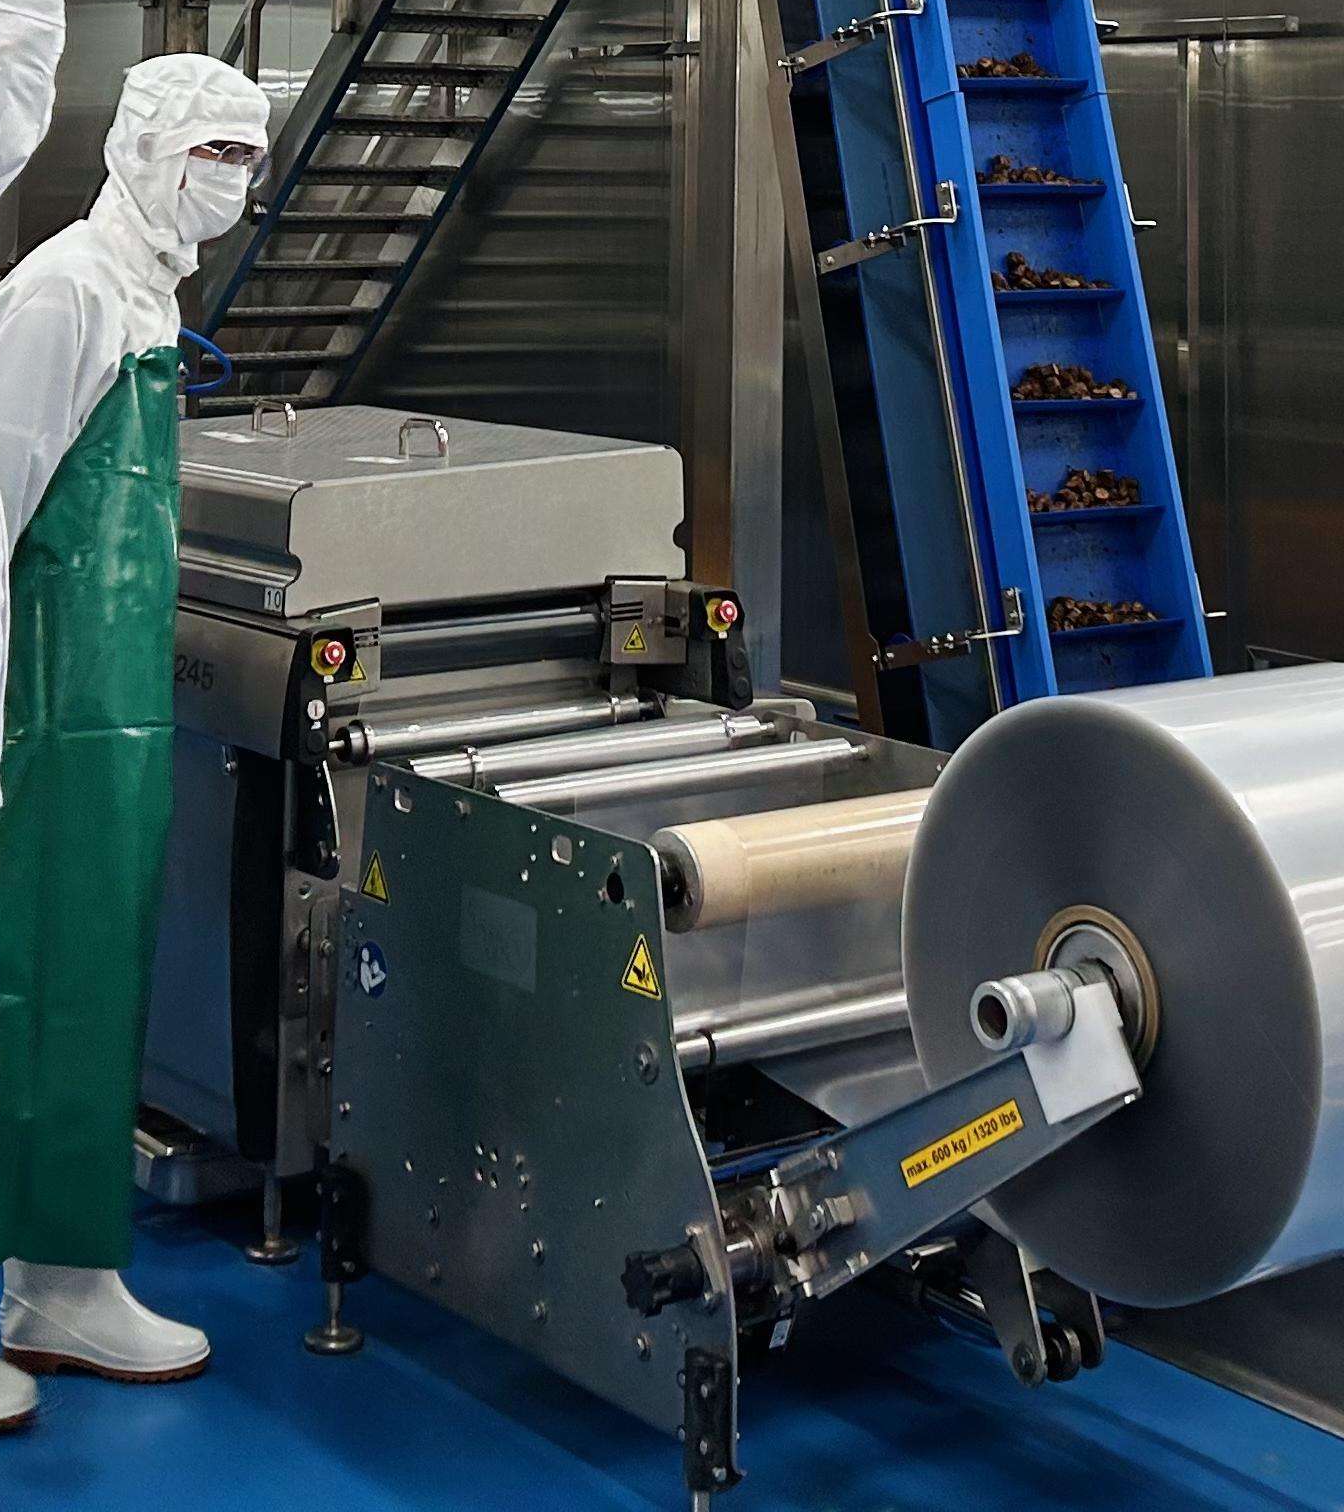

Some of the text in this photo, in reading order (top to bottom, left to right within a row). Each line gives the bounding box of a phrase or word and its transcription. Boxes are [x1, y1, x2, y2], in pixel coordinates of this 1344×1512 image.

[267, 590, 282, 608] 10
[174, 654, 214, 690] 245
[906, 1159, 932, 1178] max.
[931, 1144, 951, 1164] 600
[951, 1139, 967, 1154] kg
[973, 1118, 998, 1141] 1320
[998, 1110, 1017, 1127] lbs
